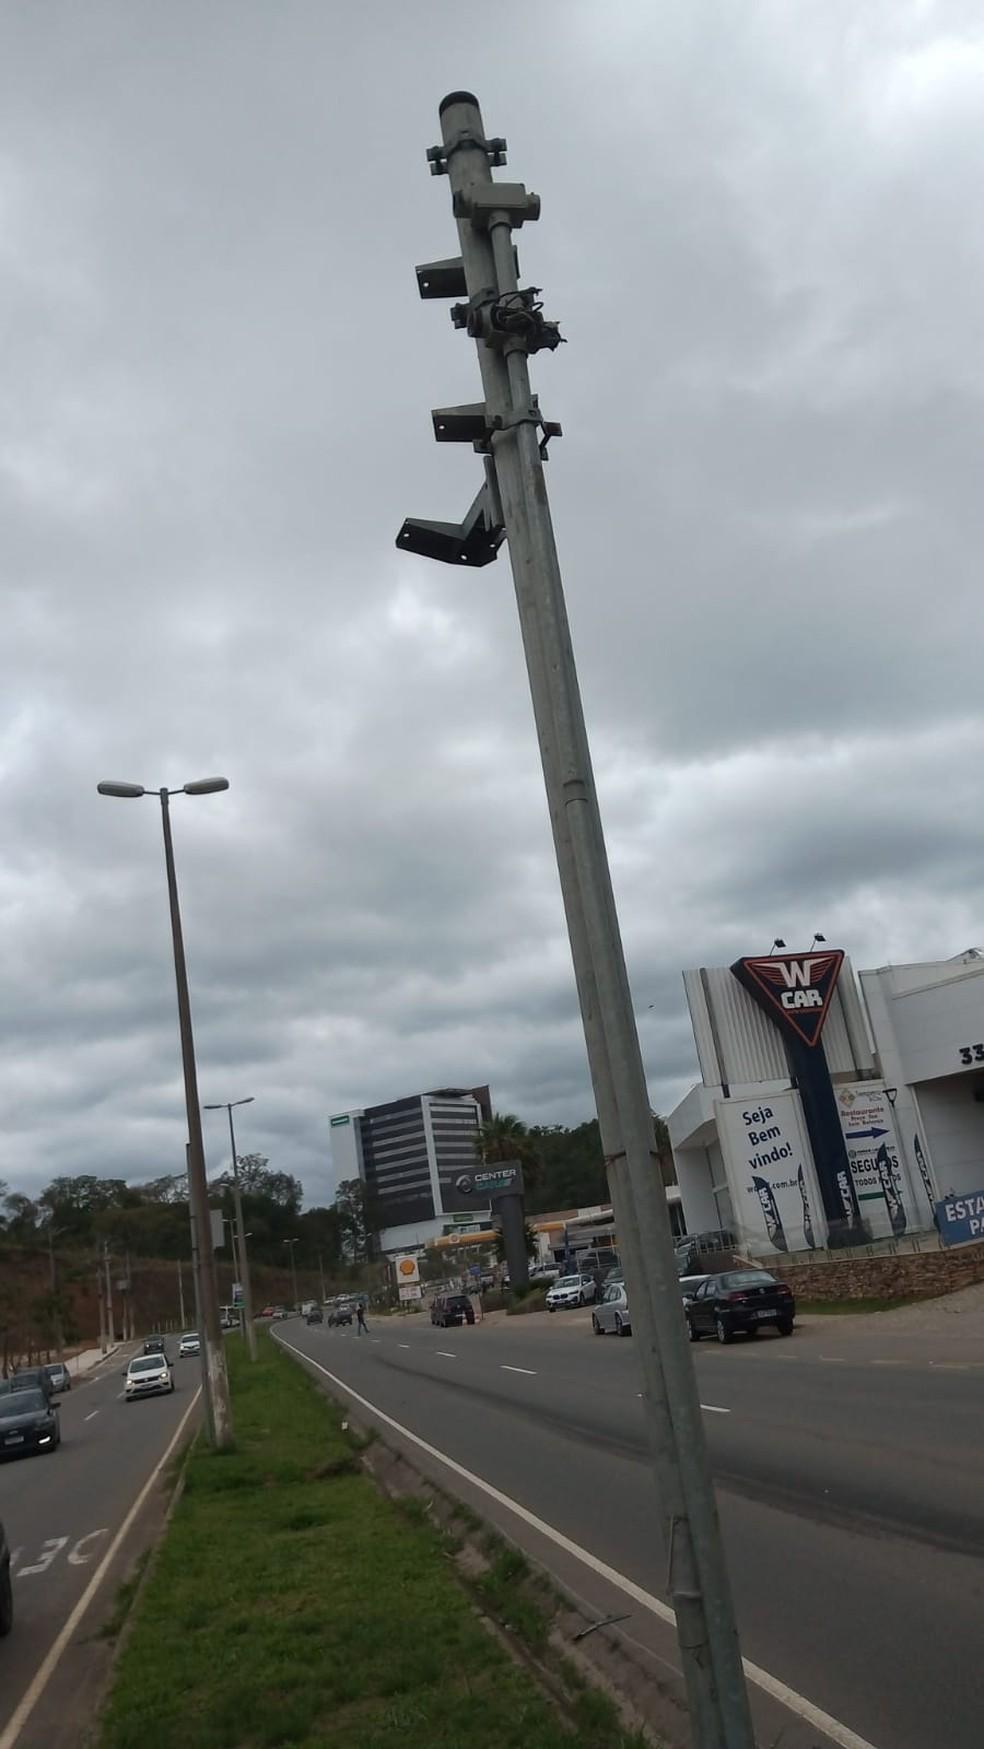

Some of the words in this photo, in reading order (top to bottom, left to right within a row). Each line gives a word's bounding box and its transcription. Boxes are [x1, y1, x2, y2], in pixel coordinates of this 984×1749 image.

[781, 989, 823, 1009] CAR
[959, 1043, 984, 1065] 33
[742, 1106, 774, 1126] Seja
[748, 1125, 781, 1146] Bem
[748, 1142, 793, 1169] vindo!
[850, 1156, 899, 1174] SEGUS
[474, 1169, 517, 1182] CENTER
[836, 1170, 850, 1199] CAR
[879, 1160, 892, 1188] CAR
[758, 1187, 772, 1212] CAR
